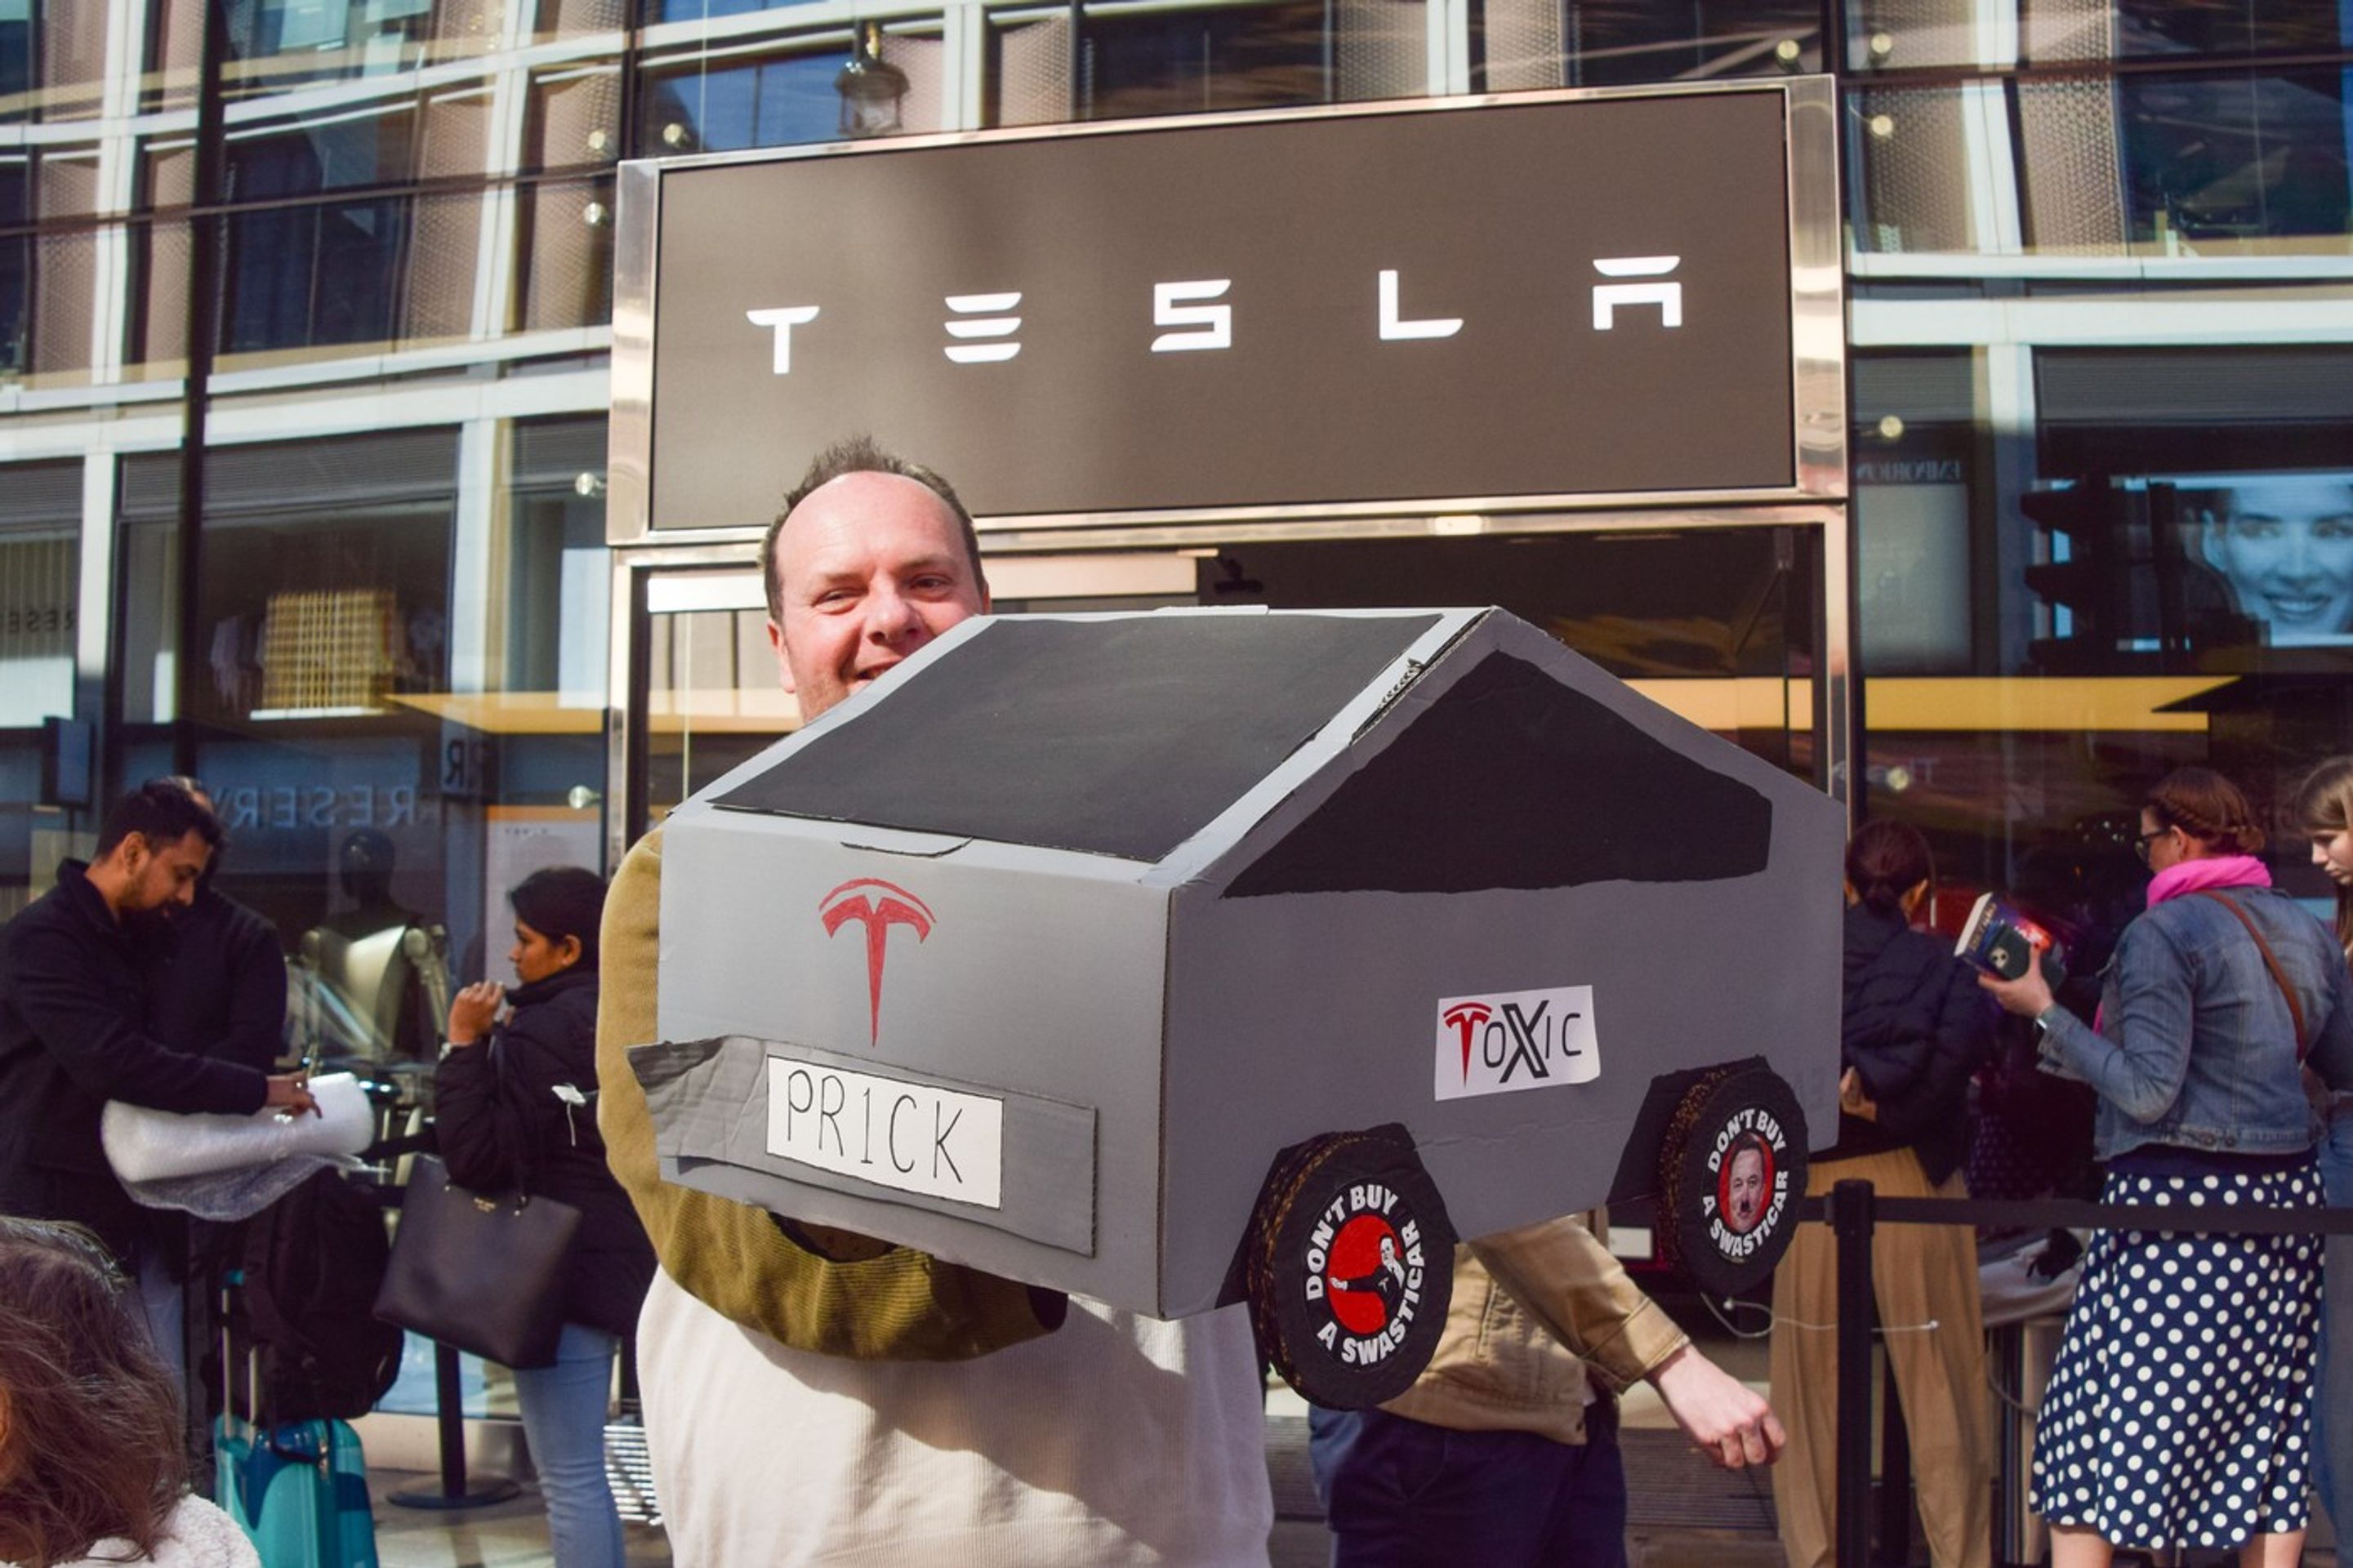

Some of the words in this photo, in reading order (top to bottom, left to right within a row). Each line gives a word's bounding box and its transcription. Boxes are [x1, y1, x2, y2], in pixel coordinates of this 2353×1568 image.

[746, 255, 1682, 376] TESLA
[1707, 1108, 1755, 1173] DON'T
[1756, 1110, 1787, 1153] BUY
[1349, 1183, 1398, 1215] BUY
[1703, 1195, 1716, 1217] A
[1709, 1170, 1789, 1257] SWASTICAR
[1306, 1195, 1347, 1301] DON'T
[1341, 1218, 1426, 1366] SWASTICAR
[1317, 1320, 1339, 1351] A
